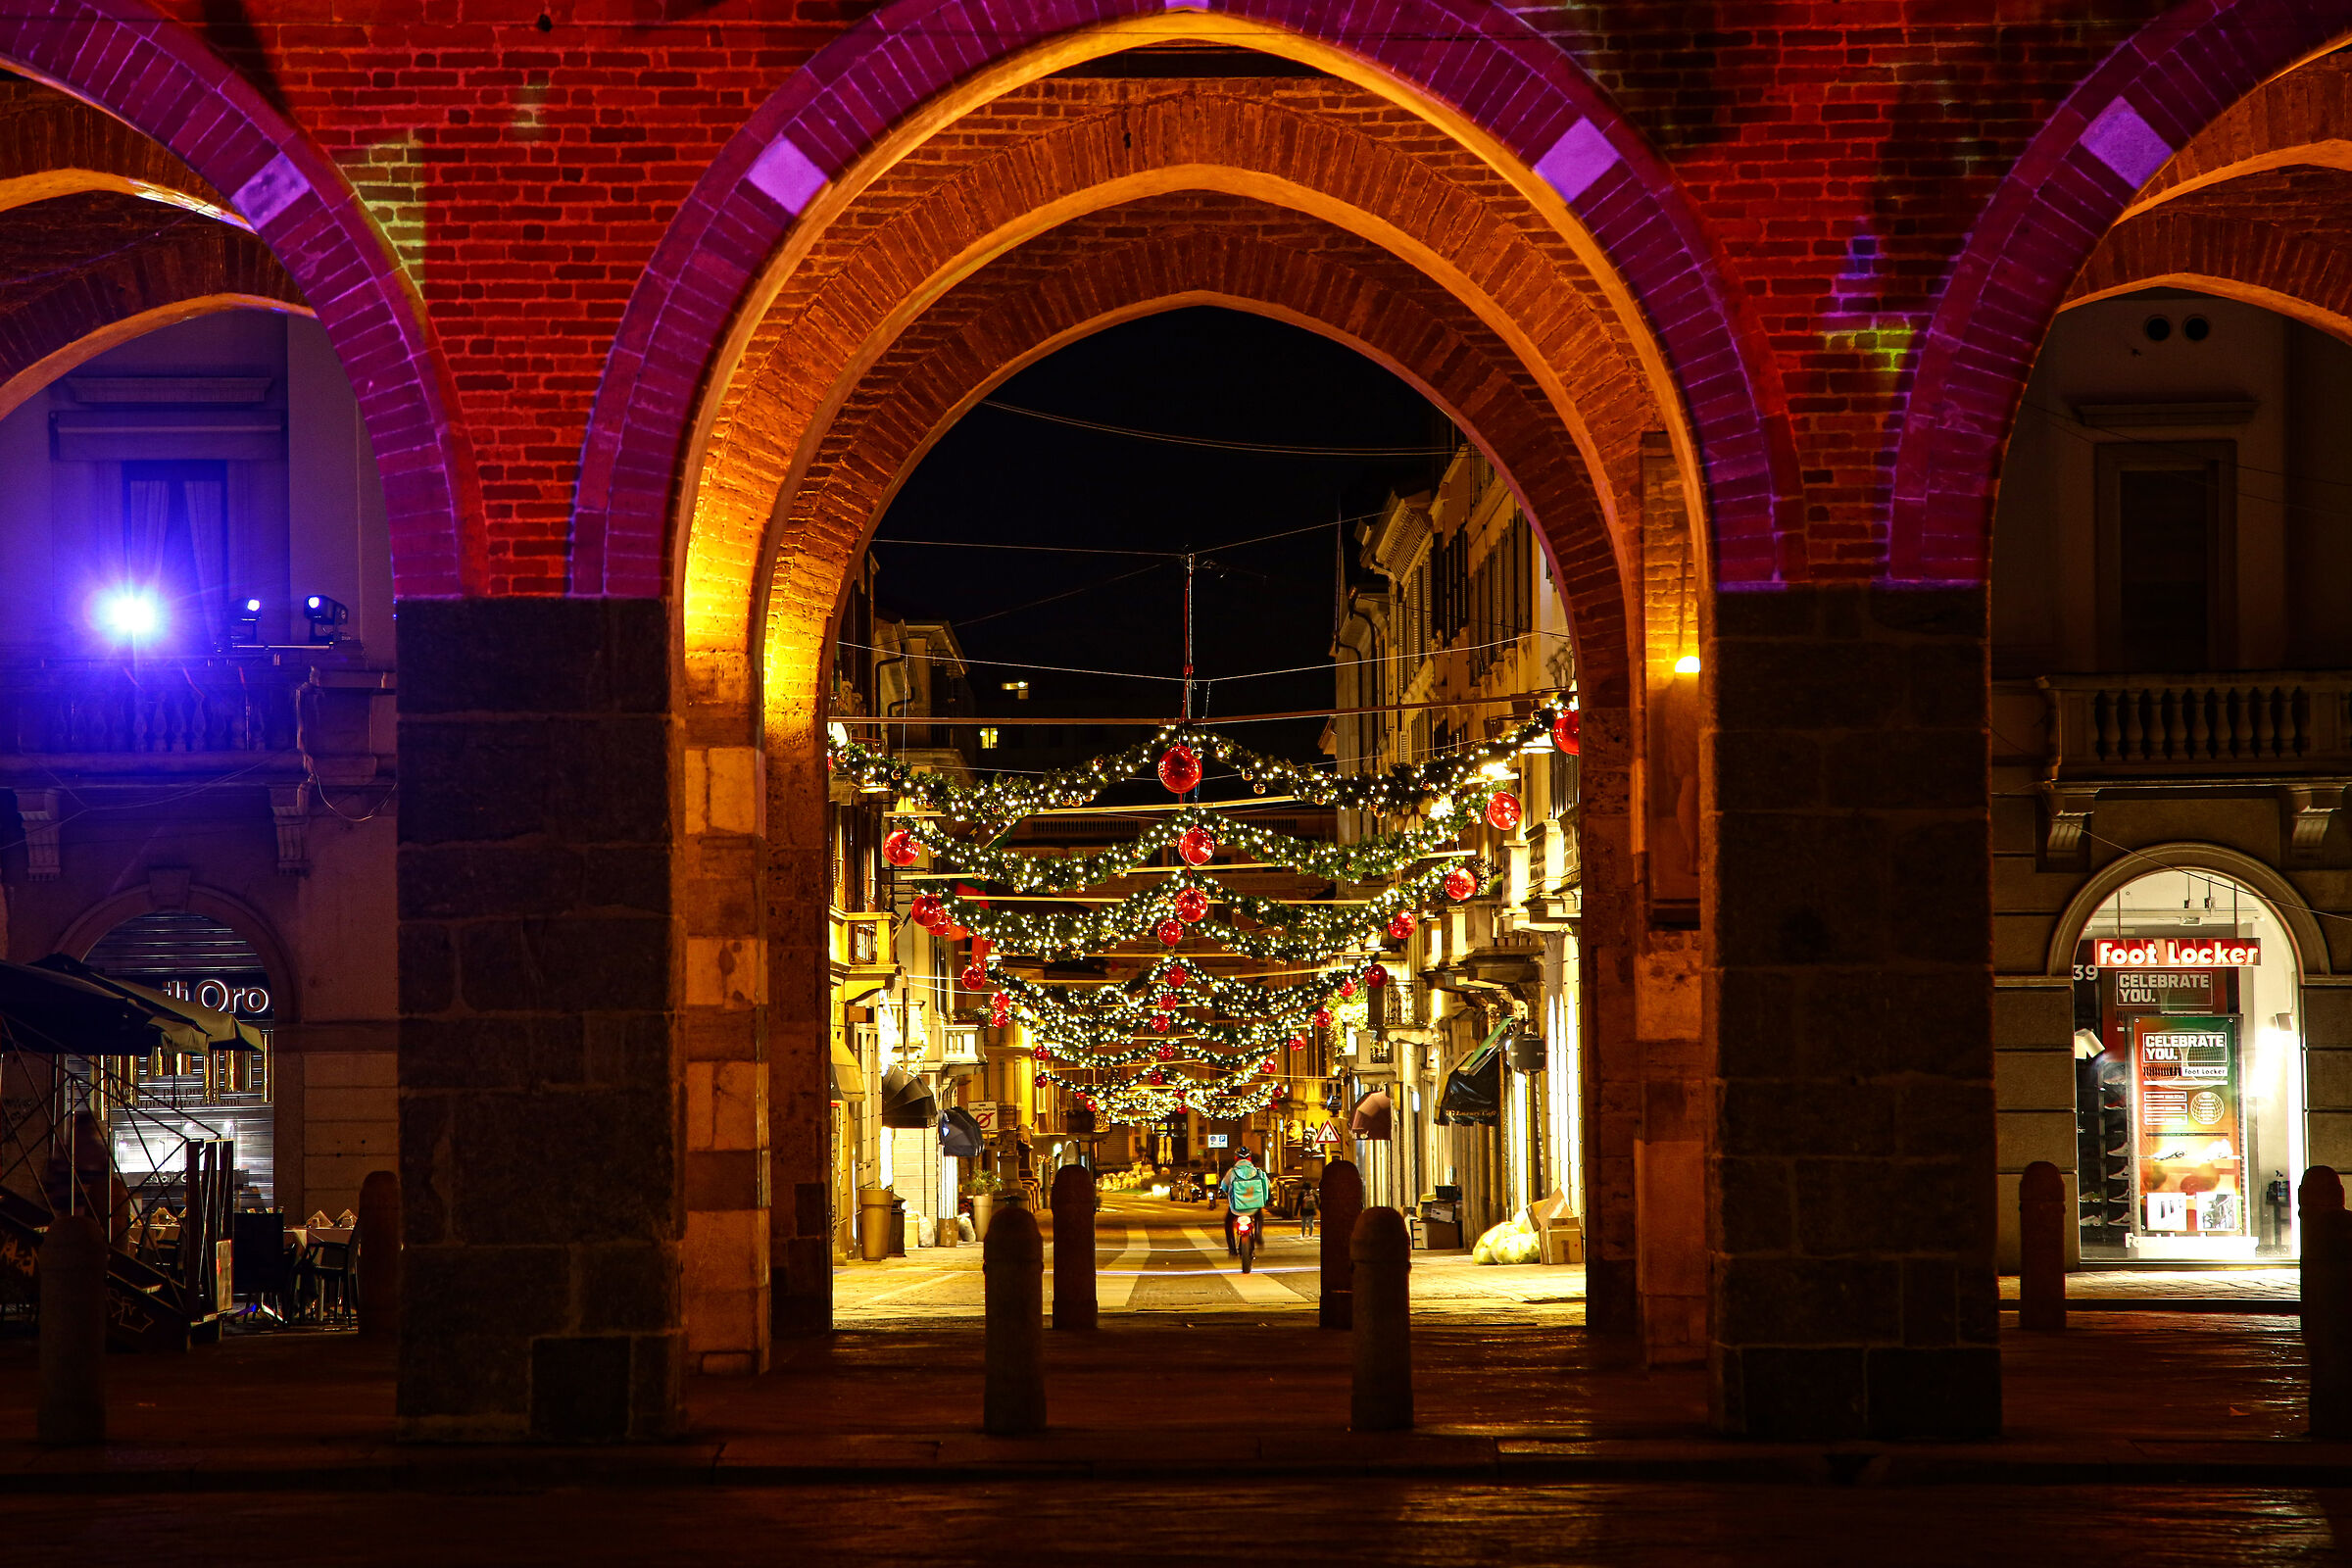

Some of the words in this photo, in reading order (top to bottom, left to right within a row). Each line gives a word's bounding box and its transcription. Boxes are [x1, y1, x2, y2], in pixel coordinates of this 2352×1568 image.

[2098, 941, 2158, 964] Foot
[2167, 941, 2259, 965] Locker
[2073, 964, 2098, 981] 39
[2119, 973, 2209, 989] CELEBRATE
[194, 979, 270, 1013] Oro
[2119, 988, 2156, 1003] YOU.
[2144, 1034, 2226, 1048] CELEBRATE
[2145, 1047, 2179, 1060] YOU.
